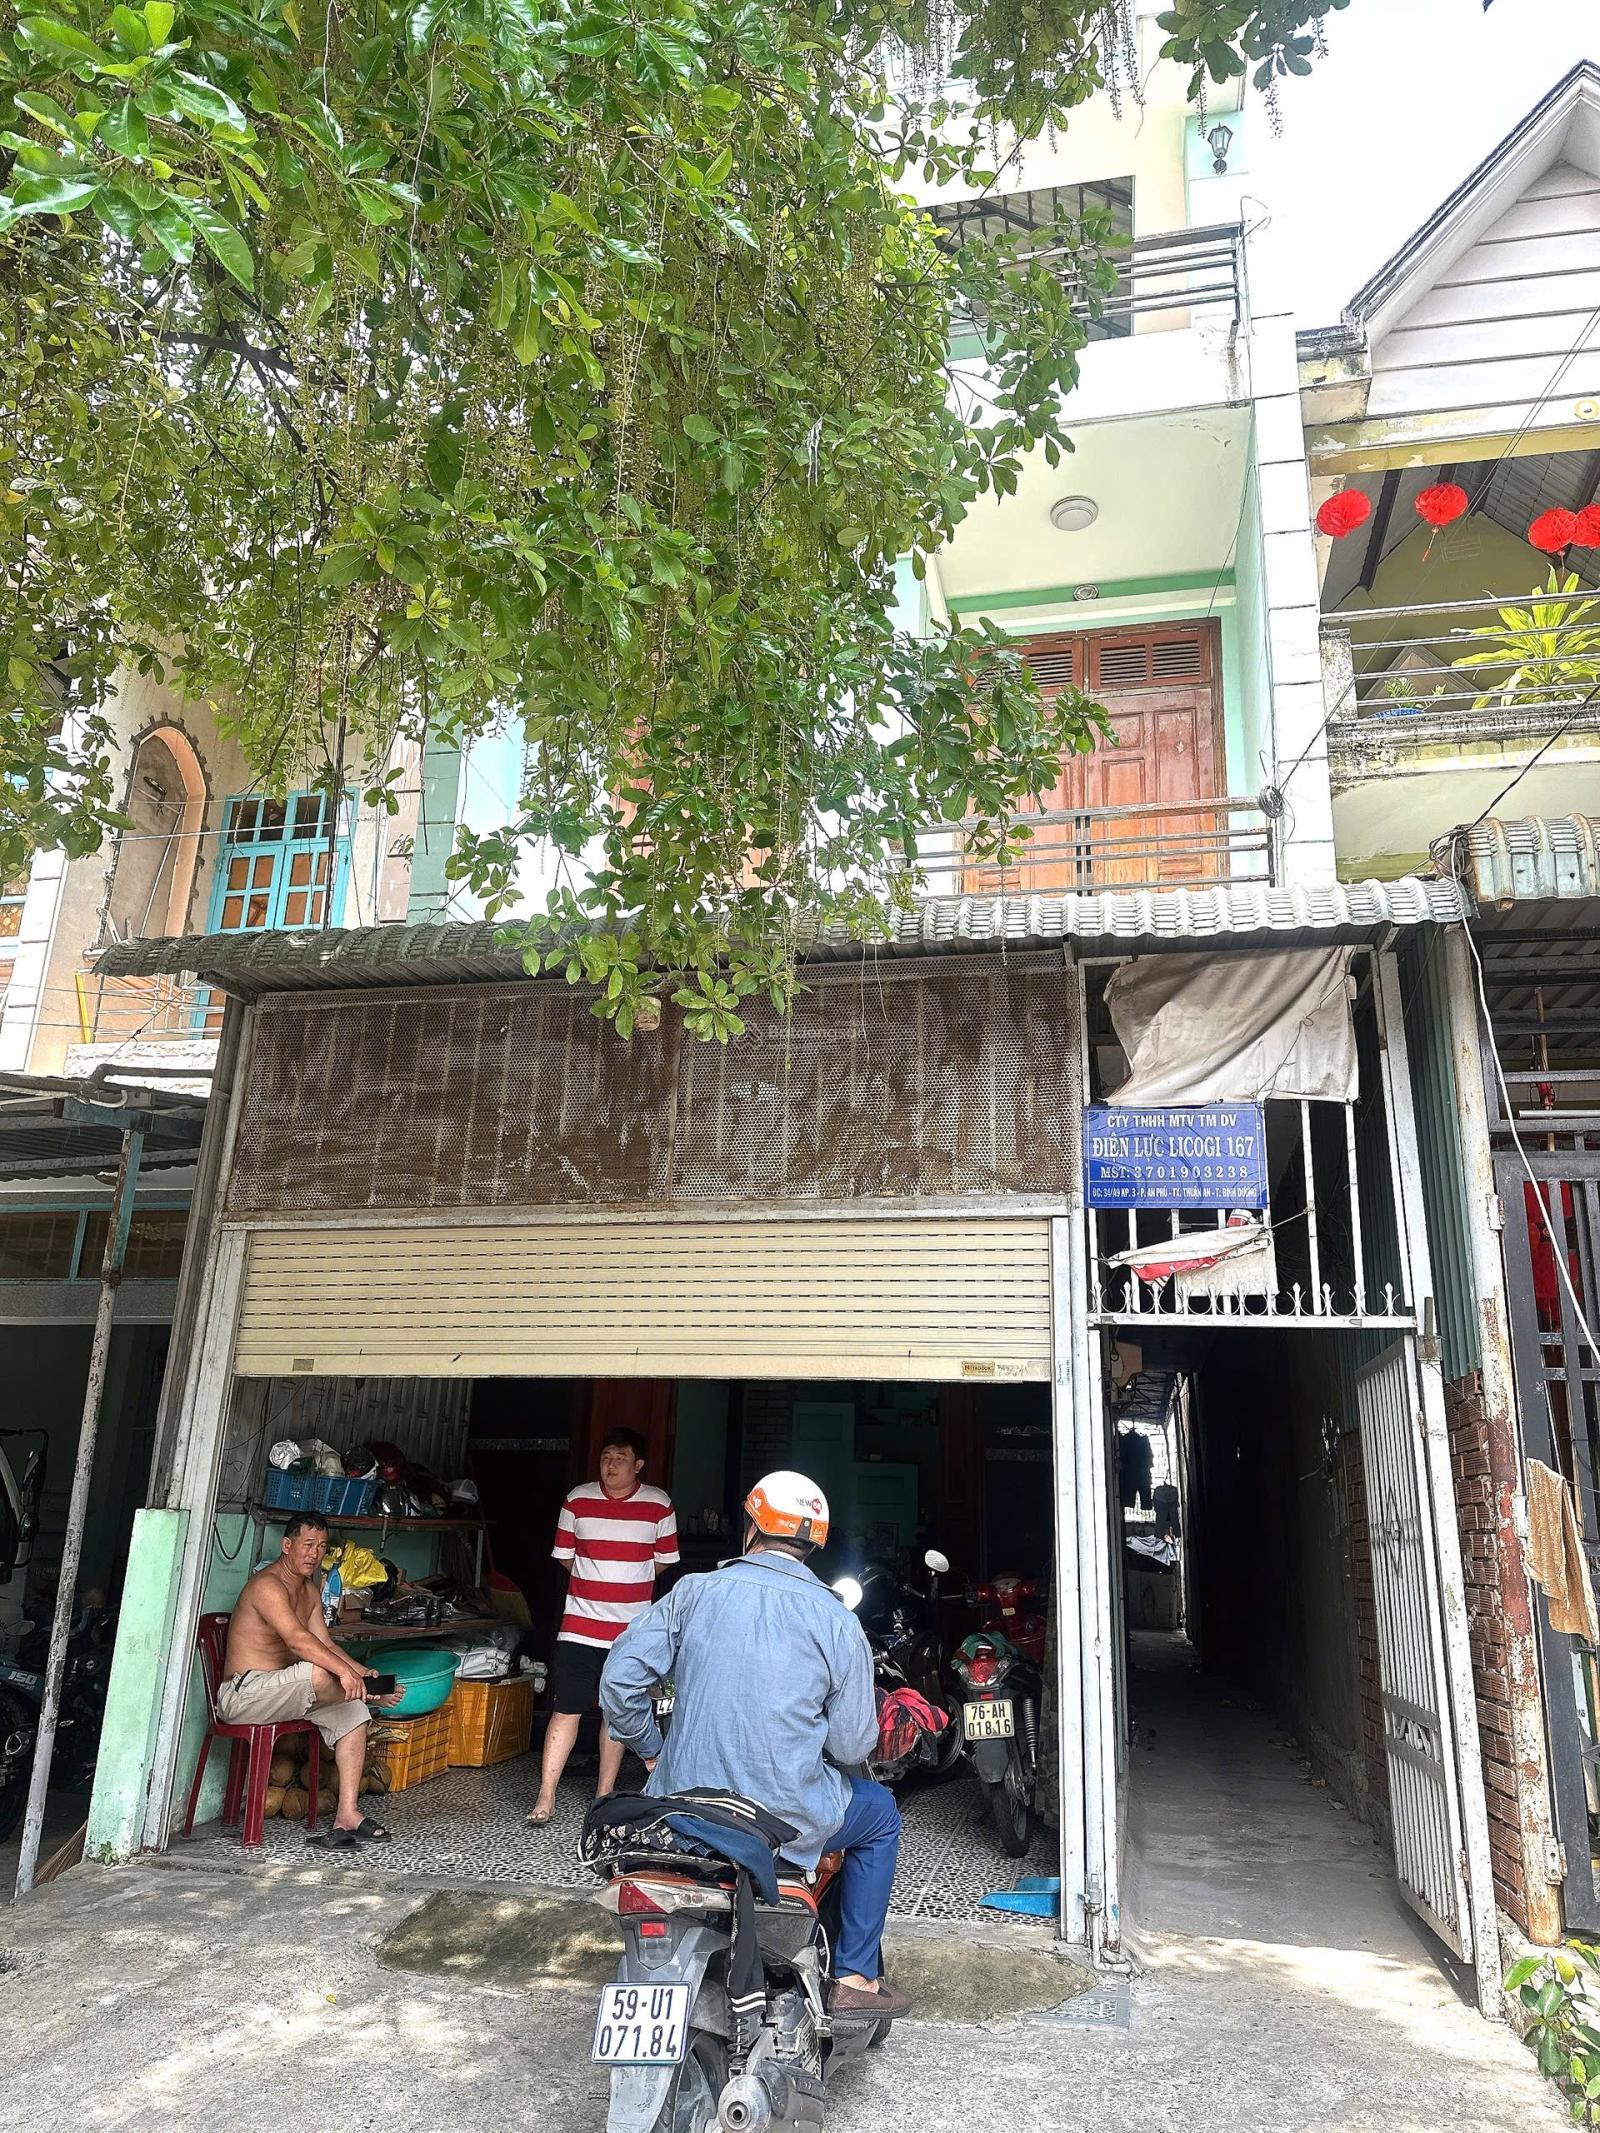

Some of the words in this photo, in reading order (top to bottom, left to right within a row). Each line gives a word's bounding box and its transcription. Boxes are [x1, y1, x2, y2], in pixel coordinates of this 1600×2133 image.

[1107, 1115, 1130, 1128] CTY
[1133, 1114, 1165, 1128] TNHH
[1169, 1114, 1195, 1127] MTV
[1198, 1114, 1217, 1127] TM
[1221, 1114, 1237, 1127] DV
[1092, 1133, 1129, 1163] ĐIỆN
[1134, 1133, 1165, 1162] LỰC
[1169, 1136, 1222, 1158] LICOGI
[1227, 1136, 1254, 1158] 167
[1100, 1166, 1130, 1179] MST:
[1131, 1187, 1136, 1198] 3
[8, 1671, 38, 1685] 150
[970, 1703, 1006, 1721] 76-AH
[612, 1988, 674, 2021] 59-U1
[599, 2024, 677, 2058] 071.84
